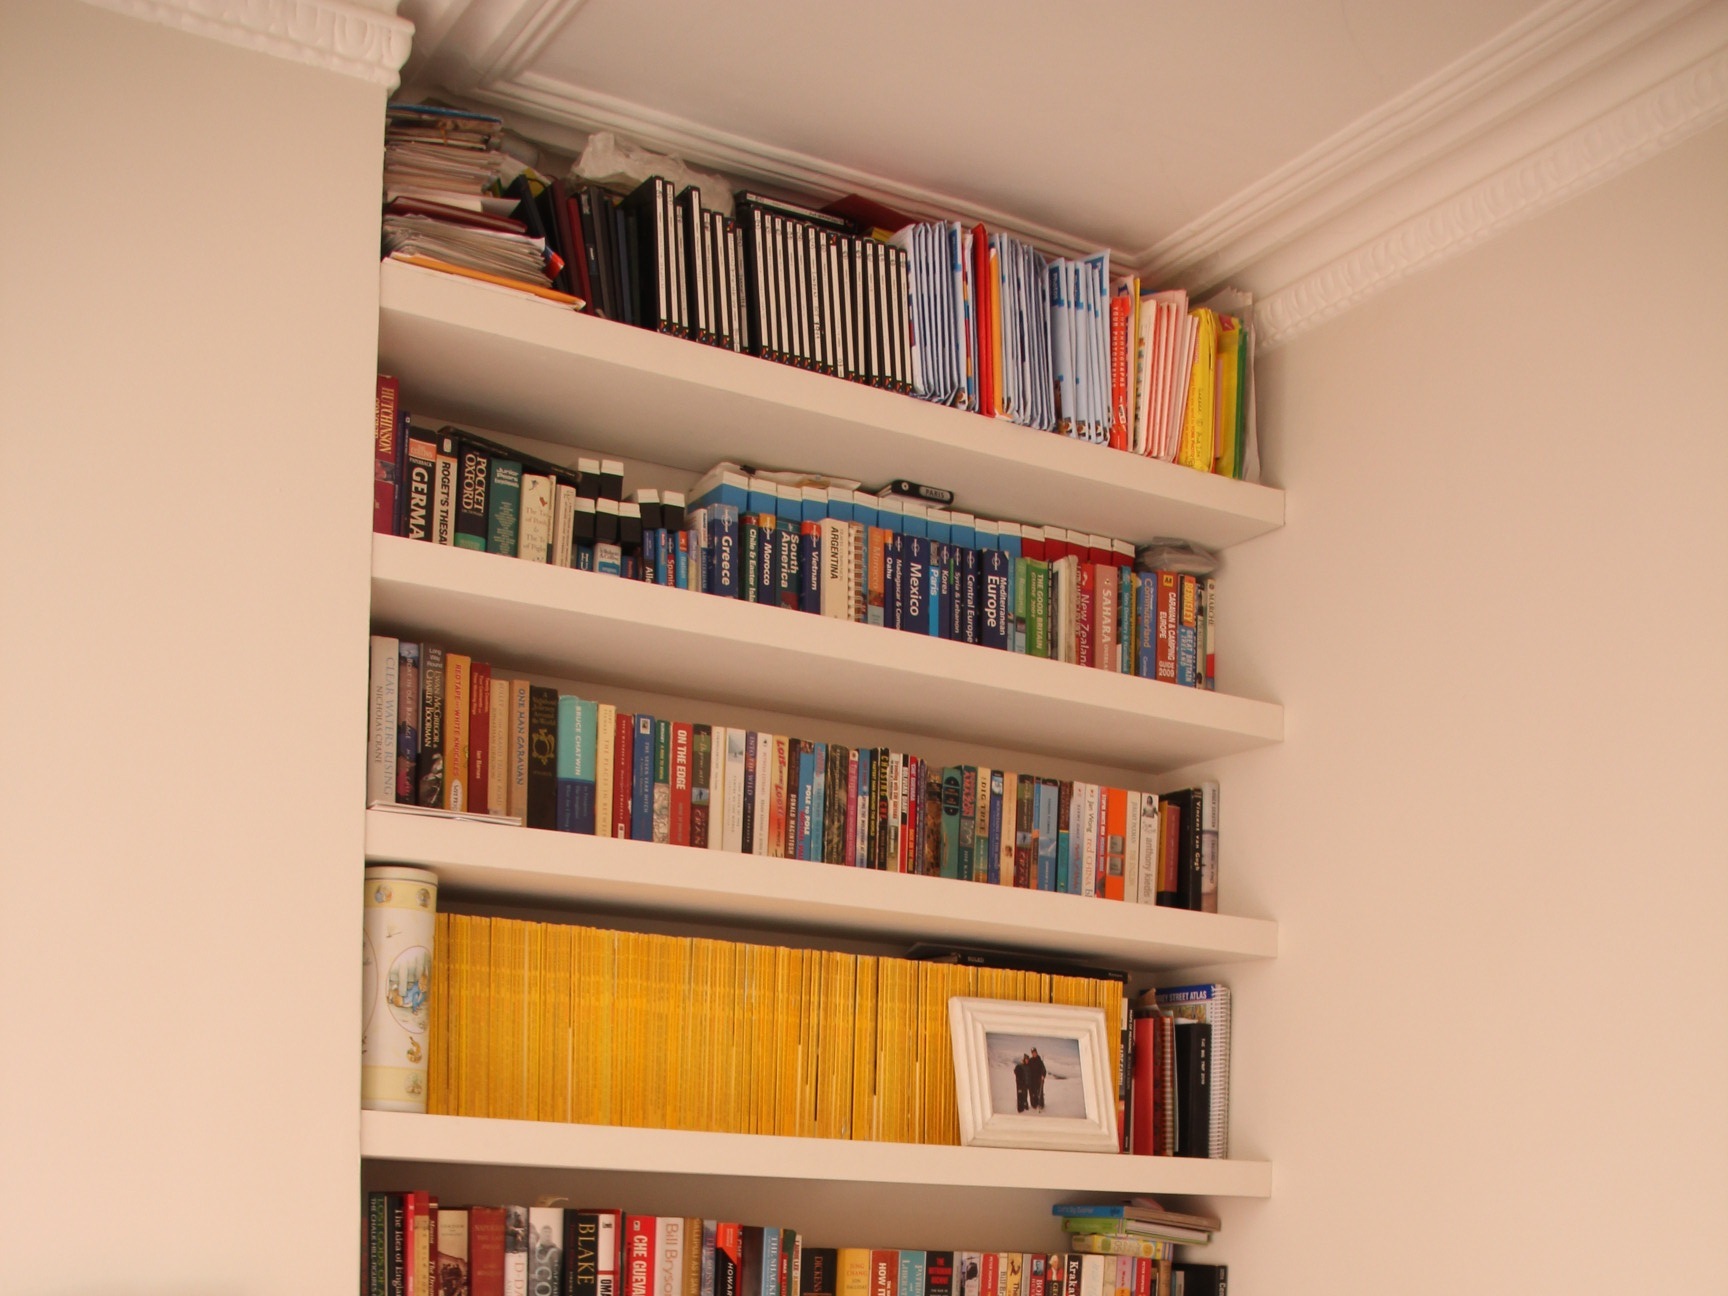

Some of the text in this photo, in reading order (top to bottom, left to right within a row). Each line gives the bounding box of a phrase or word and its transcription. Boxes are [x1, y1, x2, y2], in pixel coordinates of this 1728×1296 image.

[379, 388, 394, 454] HUTCHINSON
[462, 454, 476, 509] OXFORD
[474, 457, 487, 513] POCKET
[925, 489, 945, 498] PARIS
[721, 536, 732, 585] Greece
[763, 543, 771, 585] Morocco
[781, 532, 789, 588] America
[790, 534, 798, 573] South
[830, 527, 838, 579] ARGENTINA
[909, 563, 921, 616] Mexico
[930, 569, 938, 595] Paris
[941, 570, 949, 594] Korea
[985, 576, 999, 627] Europe
[1184, 582, 1193, 622] BERKELEY
[966, 610, 974, 642] Europe
[1102, 589, 1111, 643] SAHARA
[374, 686, 383, 764] NICHOLAS CRANE
[384, 657, 395, 796] CLEAR WATERS RISING
[676, 730, 686, 790] ON THE EDGE
[880, 755, 888, 796] CHASING
[962, 771, 970, 816] AMAZON
[1143, 837, 1153, 897] anthony kiedis
[1190, 991, 1207, 999] ATLAS
[577, 1223, 595, 1285] BLAKE
[633, 1235, 647, 1258] CHE
[666, 1223, 679, 1246] Bill
[813, 1256, 822, 1292] DICKENS
[878, 1262, 886, 1287] HOW
[1011, 1282, 1019, 1296] The
